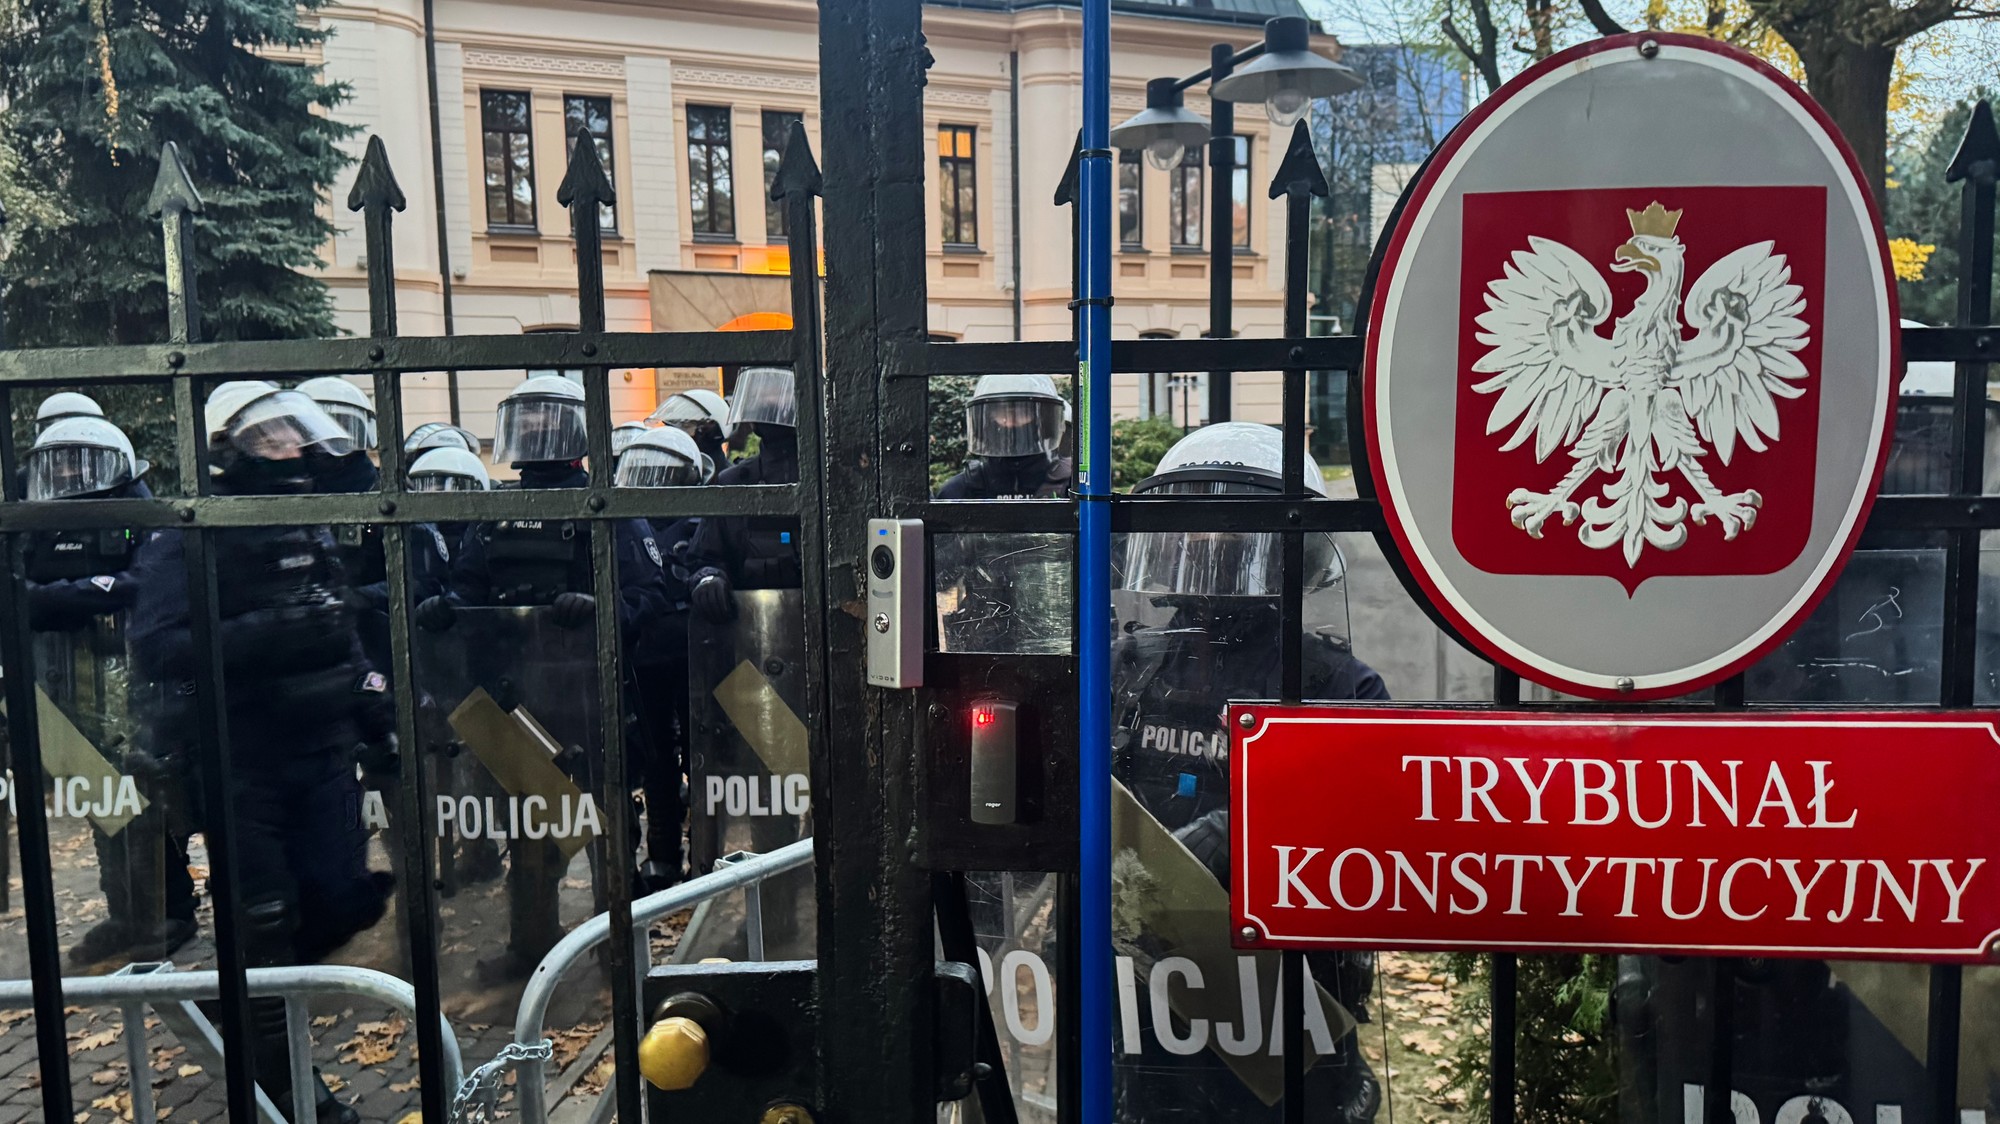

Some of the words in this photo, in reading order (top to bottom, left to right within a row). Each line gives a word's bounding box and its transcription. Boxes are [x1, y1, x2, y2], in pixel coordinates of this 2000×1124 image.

[0, 774, 143, 819] ICJA
[436, 793, 602, 840] POLICJA
[706, 773, 810, 817] POLIC
[1401, 755, 1858, 829] TRYBUNAŁ
[1271, 844, 1987, 924] KONSTYTUCYJNY
[976, 946, 1337, 1056] OICJA
